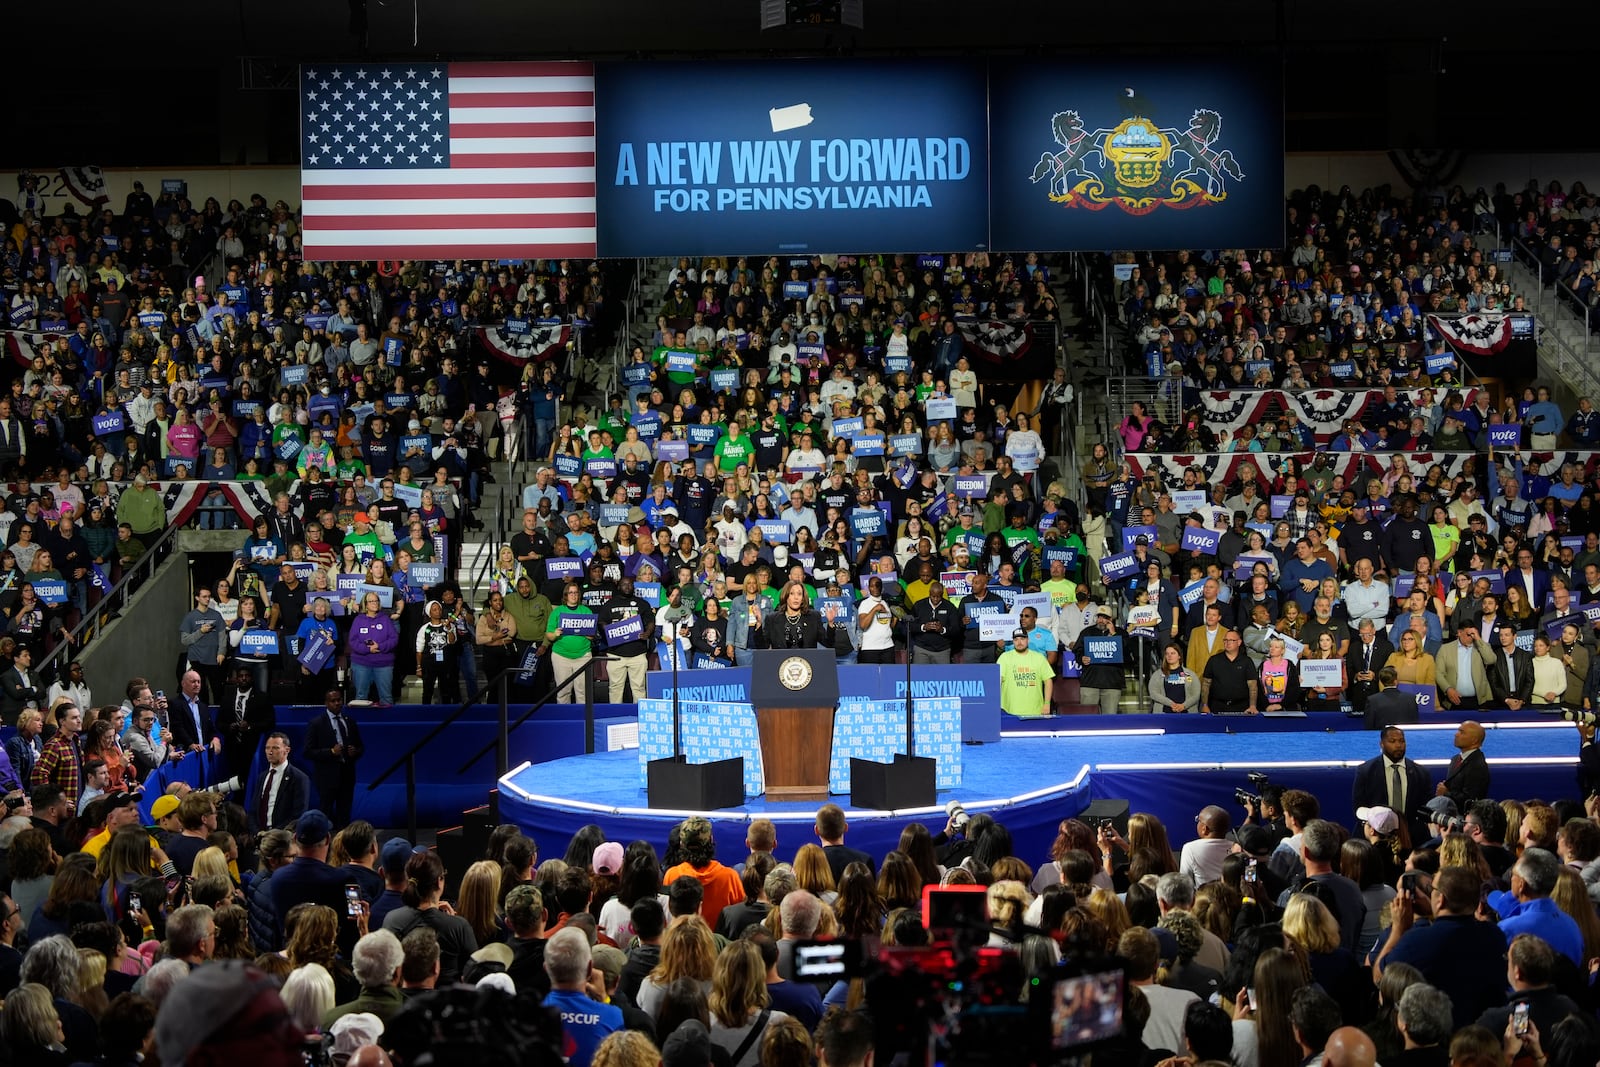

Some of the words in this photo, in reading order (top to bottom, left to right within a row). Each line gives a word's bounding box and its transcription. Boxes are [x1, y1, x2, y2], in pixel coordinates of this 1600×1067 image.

[615, 142, 638, 186] A
[647, 141, 722, 185] NEW
[729, 140, 802, 184] WAY
[810, 138, 970, 182] FORWARD
[654, 188, 710, 212] FOR
[717, 185, 932, 211] PENNSYLVANIA
[922, 258, 941, 268] vote
[786, 284, 807, 292] FREEDOM
[800, 346, 822, 354] FREEDOM
[669, 356, 694, 366] FREEDOM
[1428, 357, 1453, 368] FREEDOM
[284, 368, 304, 378] HARRIS
[714, 374, 736, 383] HARRIS
[97, 416, 120, 430] vote
[637, 422, 658, 432] HARRIS
[836, 422, 862, 432] FREEDOM
[691, 428, 714, 438] HARRIS
[1492, 430, 1516, 440] vote
[404, 438, 428, 446] HARRIS
[854, 440, 882, 448] FREEDOM
[894, 438, 916, 447] HARRIS
[556, 457, 579, 468] HARRIS
[588, 462, 614, 470] FREEDOM
[558, 465, 576, 473] WALZ
[956, 482, 984, 490] FREEDOM
[604, 508, 628, 517] HARRIS
[1502, 510, 1526, 523] HARRIS
[854, 517, 880, 528] HARRIS
[757, 525, 786, 534] FREEDOM
[1188, 534, 1214, 548] vote
[1047, 550, 1074, 561] HARRIS
[549, 562, 580, 571] FREEDOM
[1102, 556, 1134, 573] FREEDOM
[412, 568, 440, 577] HARRIS
[942, 580, 966, 588] HARRIS
[34, 586, 64, 596] FREEDOM
[1018, 598, 1046, 606] PENNSYLVANIA
[970, 607, 999, 618] HARRIS
[562, 618, 595, 628] FREEDOM
[608, 622, 640, 638] FREEDOM
[242, 634, 276, 645] FREEDOM
[1089, 642, 1117, 652] HARRIS
[1014, 672, 1036, 680] HARRIS
[1416, 692, 1430, 706] te
[640, 702, 647, 710] PA
[656, 703, 670, 712] ERIE,
[687, 704, 700, 713] ERIE,
[702, 705, 710, 713] PA
[718, 705, 732, 715] ERIE,
[734, 706, 742, 715] PA
[850, 704, 864, 714] ERIE,
[867, 704, 875, 712] PA
[884, 703, 898, 712] ERIE,
[918, 701, 932, 711] ERIE,
[934, 702, 942, 710] PA
[646, 713, 659, 722] ERIE,
[661, 714, 668, 722] PA
[692, 715, 699, 724] PA
[708, 716, 722, 725] ERIE,
[724, 717, 731, 725] PA
[740, 718, 754, 727] ERIE,
[838, 715, 853, 726] ERIE,
[855, 715, 864, 724] PA
[872, 714, 887, 724] ERIE,
[889, 714, 897, 722] PA
[923, 712, 931, 721] PA
[940, 712, 954, 722] ERIE,
[651, 724, 658, 732] PA
[697, 726, 711, 736] ERIE,
[713, 727, 720, 735] PA
[729, 728, 743, 737] ERIE,
[745, 729, 753, 737] PA
[844, 726, 852, 735] PA
[861, 725, 876, 735] ERIE,
[878, 725, 886, 734] PA
[929, 723, 943, 733] ERIE,
[945, 723, 953, 731] PA
[640, 734, 648, 742] PA
[656, 735, 670, 744] ERIE,
[687, 736, 700, 746] ERIE,
[703, 737, 710, 746] PA
[719, 738, 733, 747] ERIE,
[734, 739, 742, 747] PA
[850, 737, 865, 747] ERIE,
[867, 736, 875, 745] PA
[884, 735, 899, 745] ERIE,
[918, 734, 932, 744] ERIE,
[934, 734, 942, 742] PA
[646, 745, 659, 754] ERIE,
[661, 745, 668, 754] PA
[692, 747, 700, 756] PA
[708, 748, 722, 758] ERIE,
[724, 749, 732, 757] PA
[838, 748, 853, 758] ERIE,
[855, 748, 864, 757] PA
[872, 747, 887, 757] ERIE,
[889, 747, 897, 755] PA
[923, 745, 931, 753] PA
[940, 744, 954, 754] ERIE,
[945, 755, 953, 764] PA
[746, 762, 754, 770] PA
[832, 771, 840, 779] PA
[940, 777, 954, 787] ERIE,
[560, 1012, 600, 1024] PSCUF
